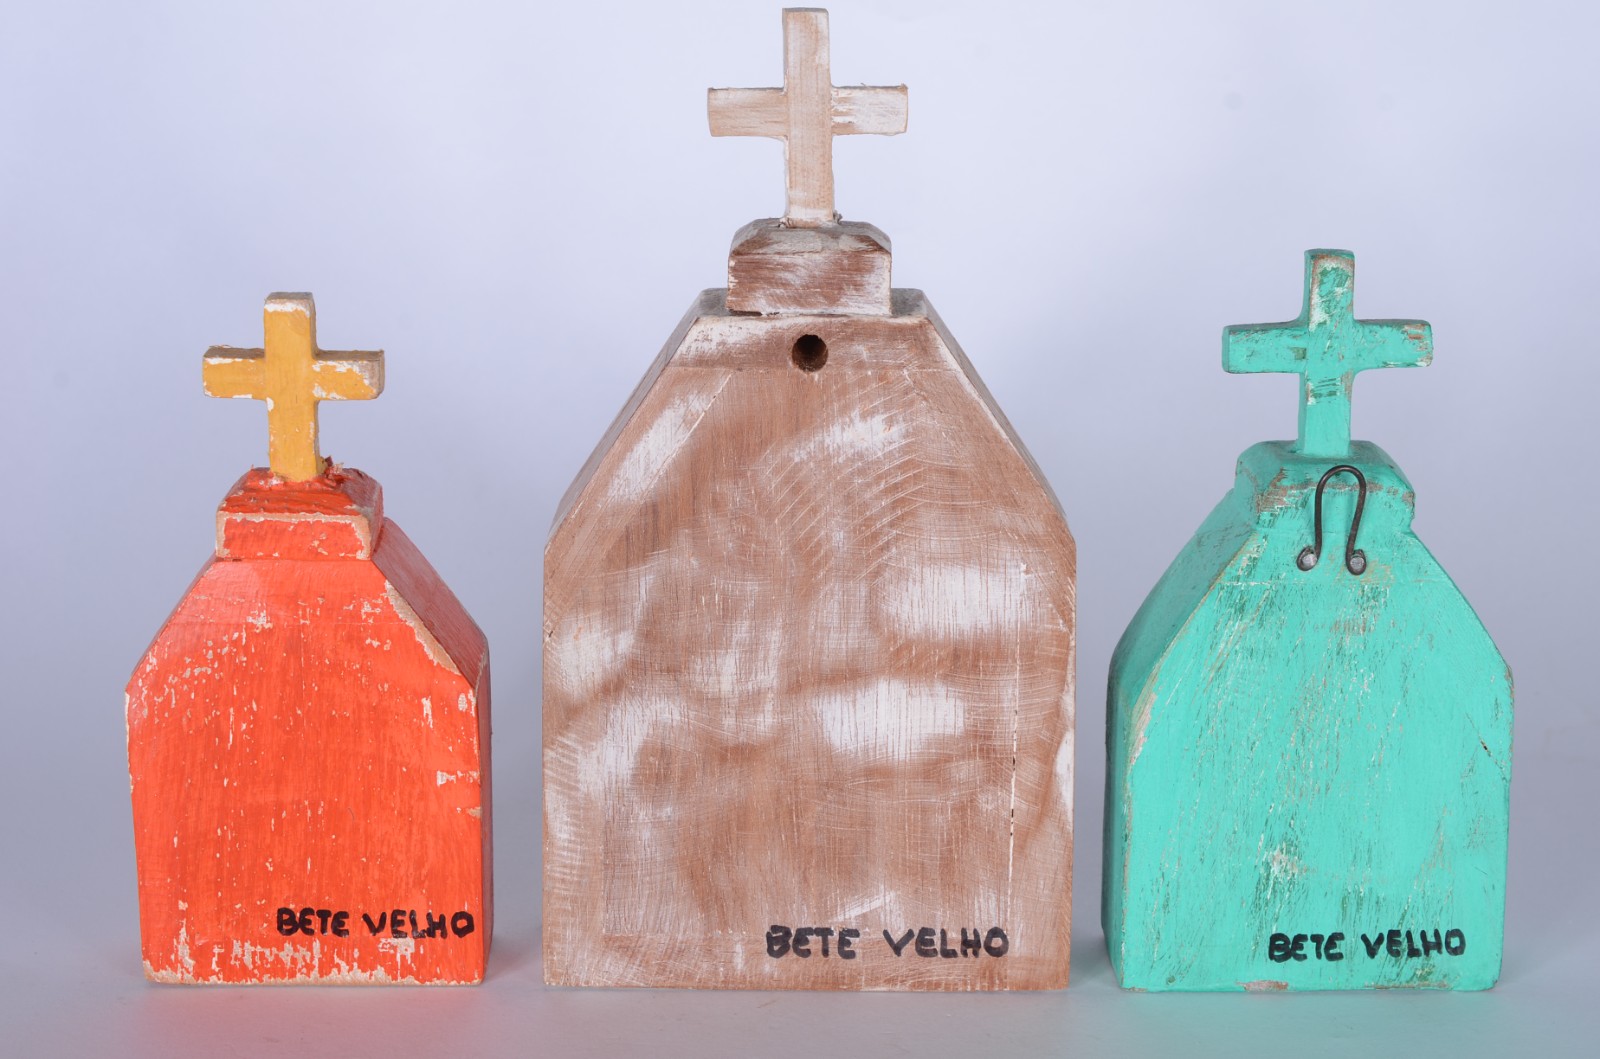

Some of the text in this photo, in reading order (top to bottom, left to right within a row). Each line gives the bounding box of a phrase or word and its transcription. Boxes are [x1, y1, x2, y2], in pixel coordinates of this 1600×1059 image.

[277, 907, 476, 940] BETE VELHO
[765, 924, 1010, 960] BETE VELHO
[1268, 928, 1466, 963] BETE VELHO
